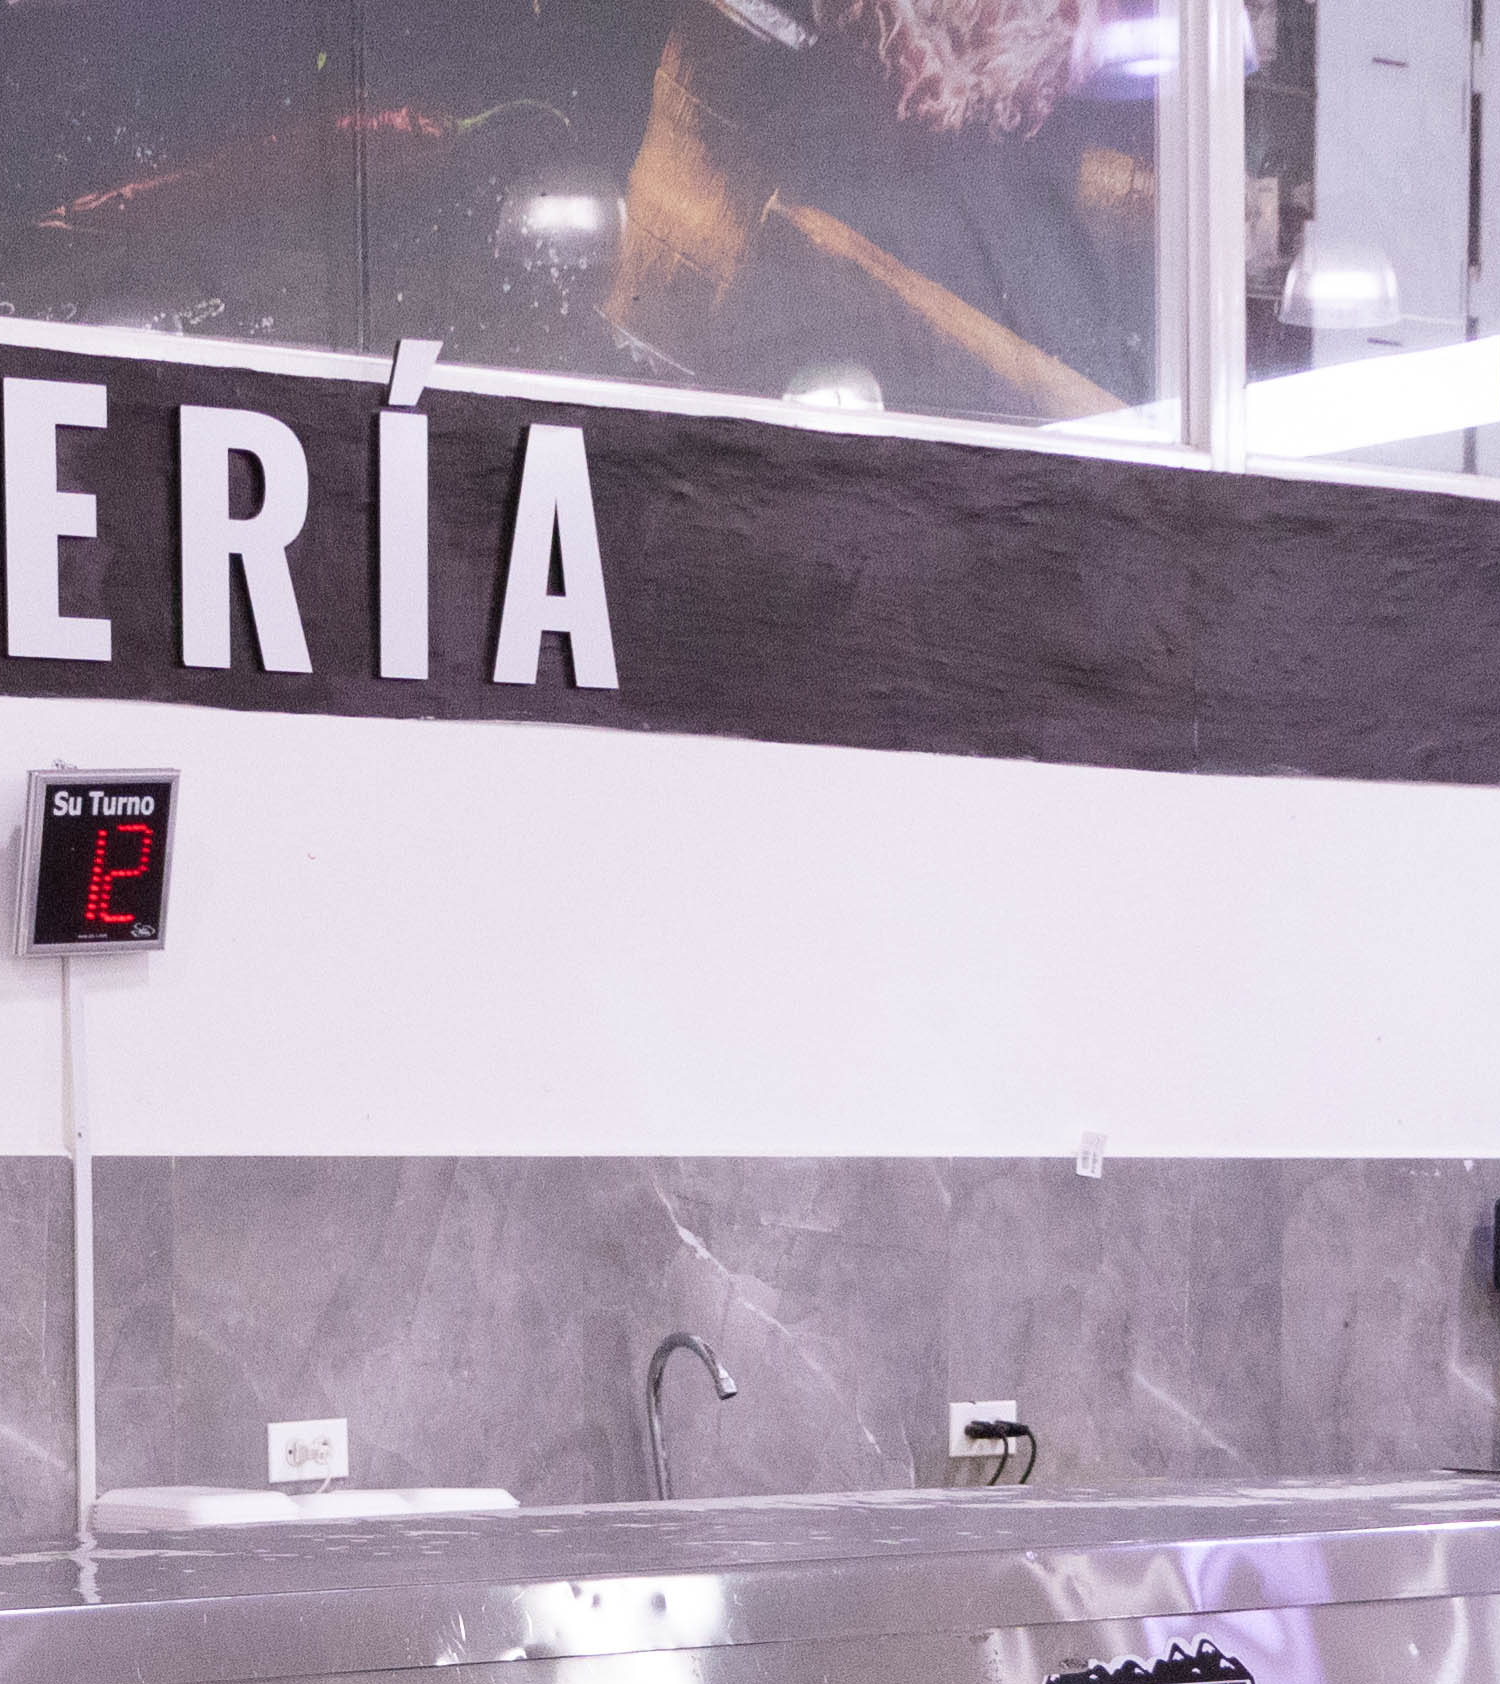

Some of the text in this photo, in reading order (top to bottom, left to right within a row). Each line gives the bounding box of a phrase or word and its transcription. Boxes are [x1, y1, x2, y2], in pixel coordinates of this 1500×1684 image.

[53, 791, 155, 816] Su Turno
[85, 825, 153, 921] 12
